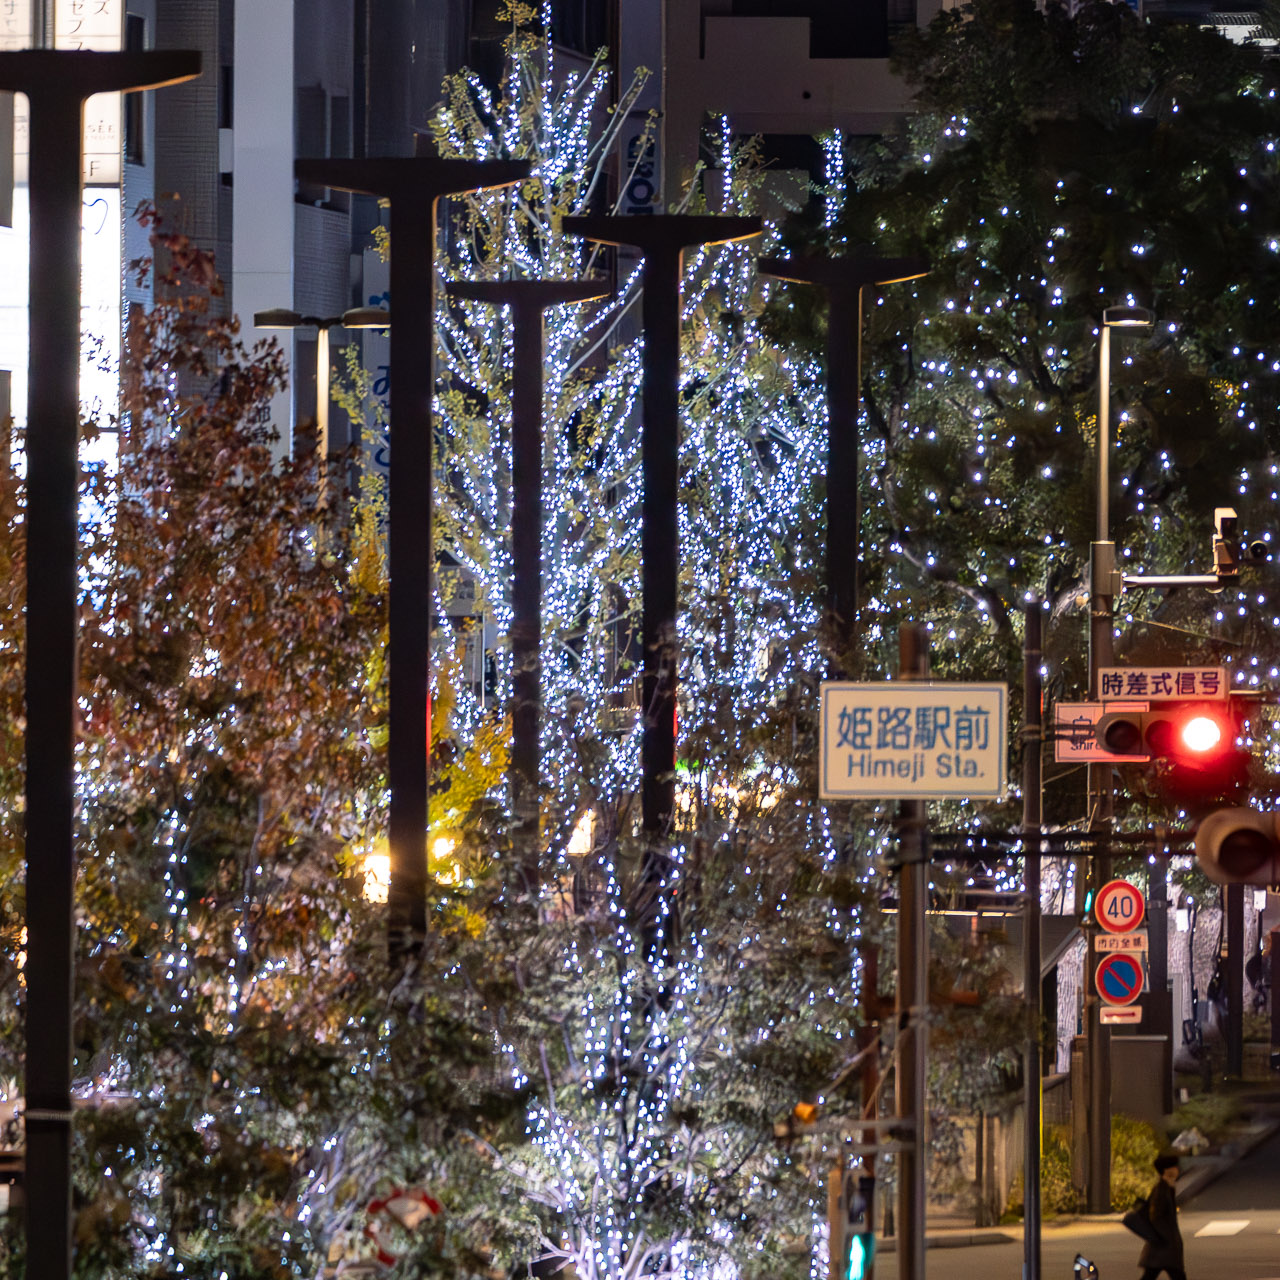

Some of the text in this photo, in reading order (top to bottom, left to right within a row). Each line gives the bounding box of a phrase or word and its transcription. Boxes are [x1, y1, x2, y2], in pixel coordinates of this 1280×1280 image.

[1102, 670, 1221, 696] 時差式信号
[836, 704, 991, 751] 姫路駅前
[847, 752, 986, 783] Himeji Sta.
[1107, 895, 1134, 919] 40
